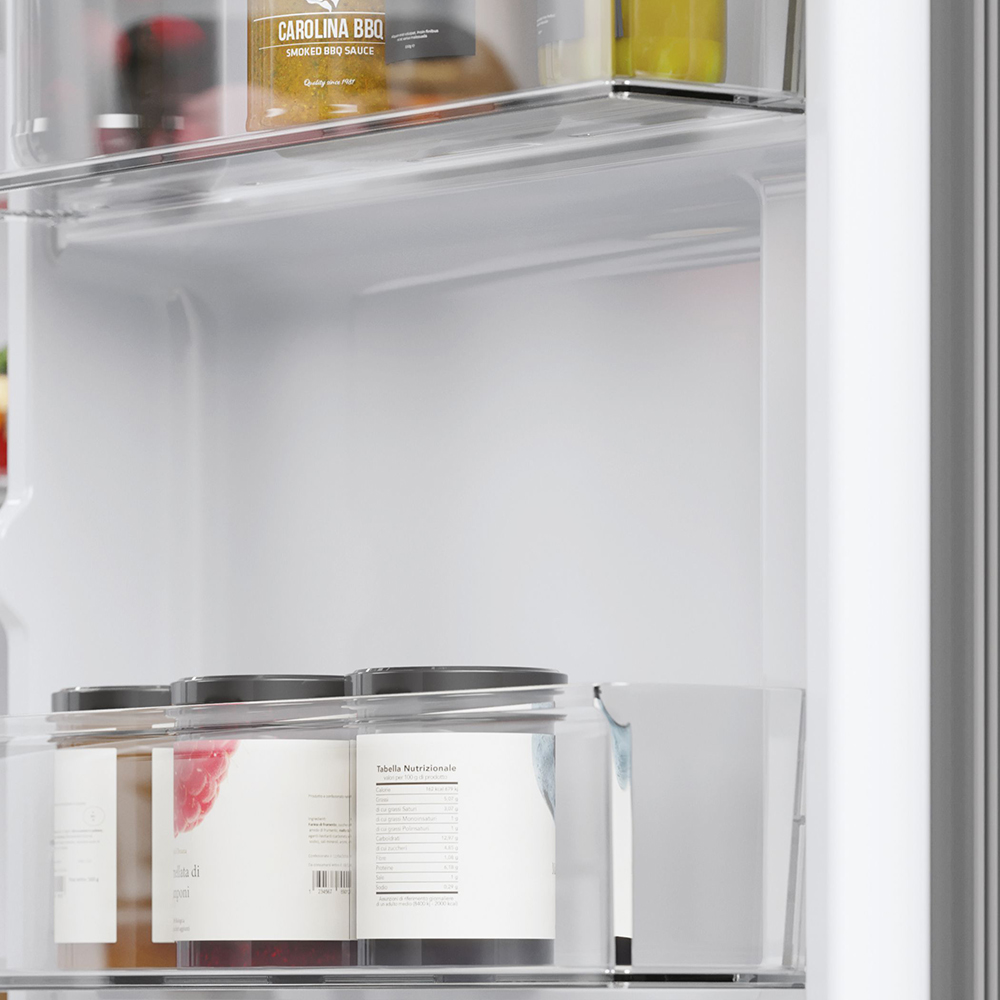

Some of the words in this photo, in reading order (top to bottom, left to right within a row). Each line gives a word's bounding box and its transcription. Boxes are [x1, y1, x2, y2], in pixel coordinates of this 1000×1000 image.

[278, 18, 349, 41] CAROLINA
[354, 18, 384, 40] BBQ
[286, 47, 322, 57] SMOKED
[323, 46, 342, 56] BBQ
[344, 46, 375, 55] SAUCE
[303, 78, 326, 87] Quality
[377, 764, 401, 773] Tabella
[403, 764, 457, 772] Nutrizionale
[190, 864, 200, 878] di
